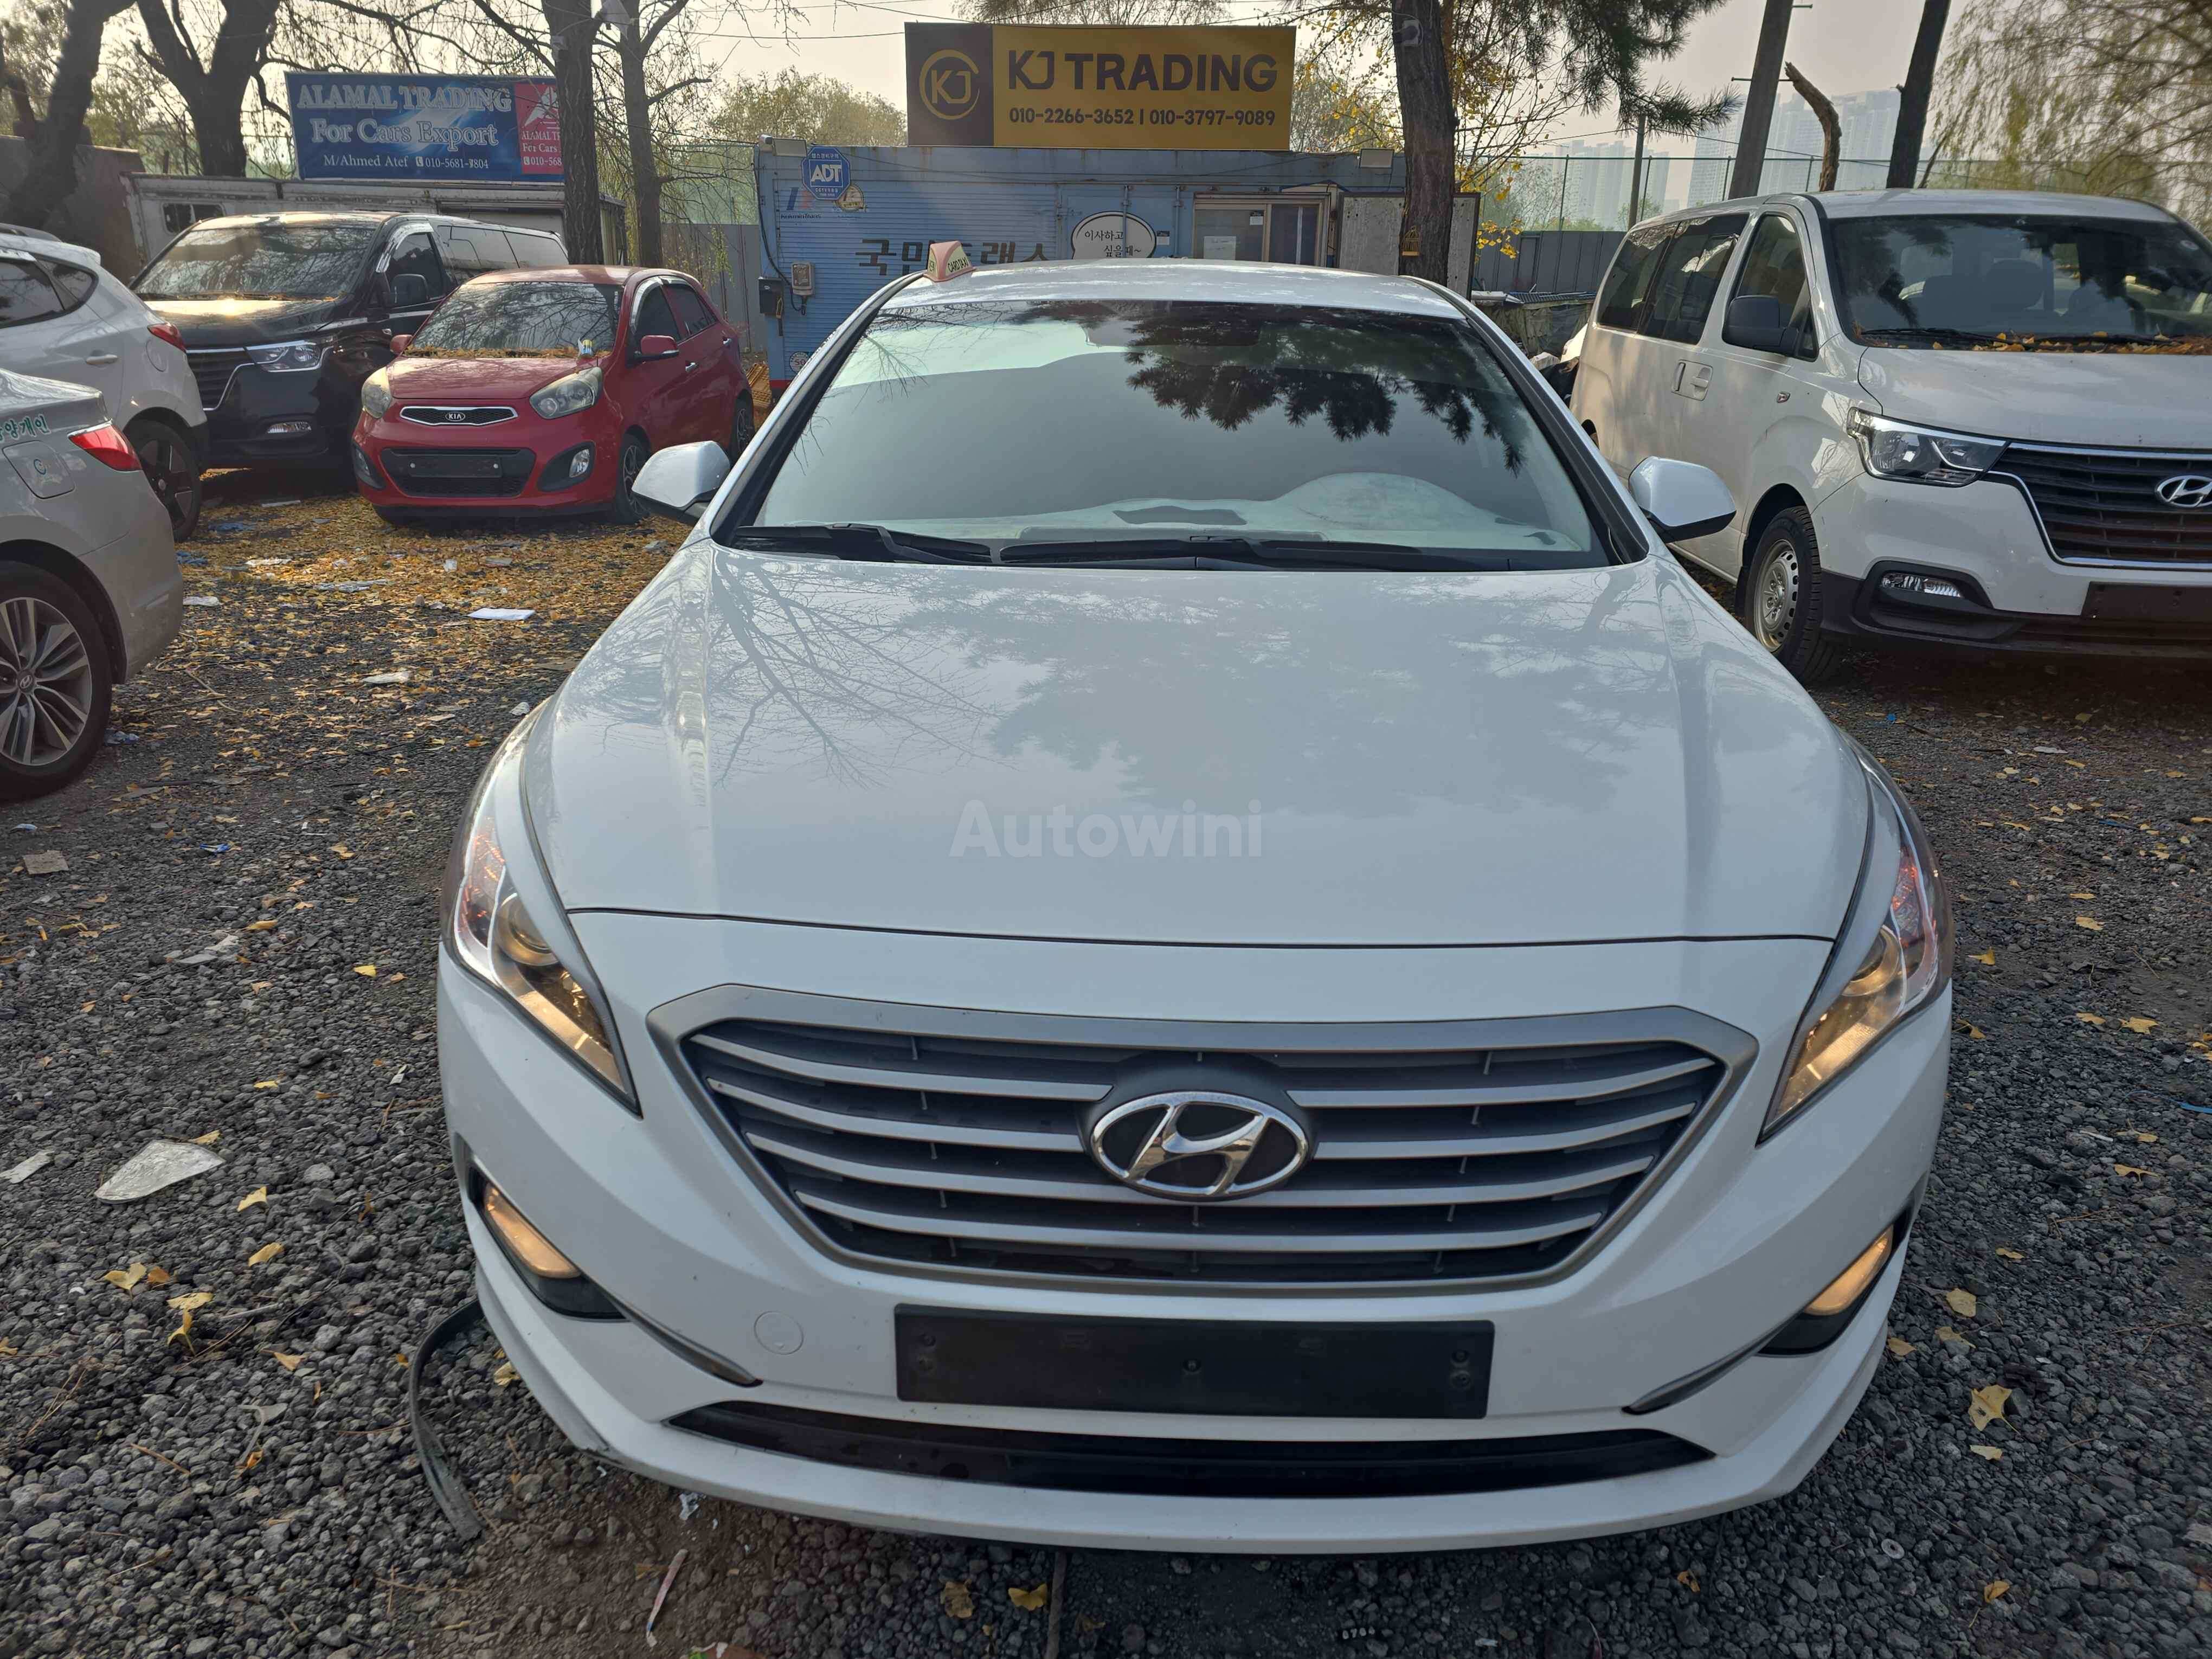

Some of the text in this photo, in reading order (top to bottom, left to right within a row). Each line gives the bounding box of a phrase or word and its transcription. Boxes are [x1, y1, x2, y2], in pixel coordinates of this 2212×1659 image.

[1008, 50, 1278, 92] KJ TRADING
[931, 69, 972, 104] KJ
[297, 85, 512, 112] ALAMAL TRADING
[1009, 107, 1276, 126] 010-2266-3652 010-3797-9089
[310, 118, 499, 152] For Cars Export
[539, 143, 557, 153] Cars
[324, 154, 408, 168] M/Ahmed Atef
[811, 164, 841, 182] ADT
[1084, 229, 1124, 241] 이사하고
